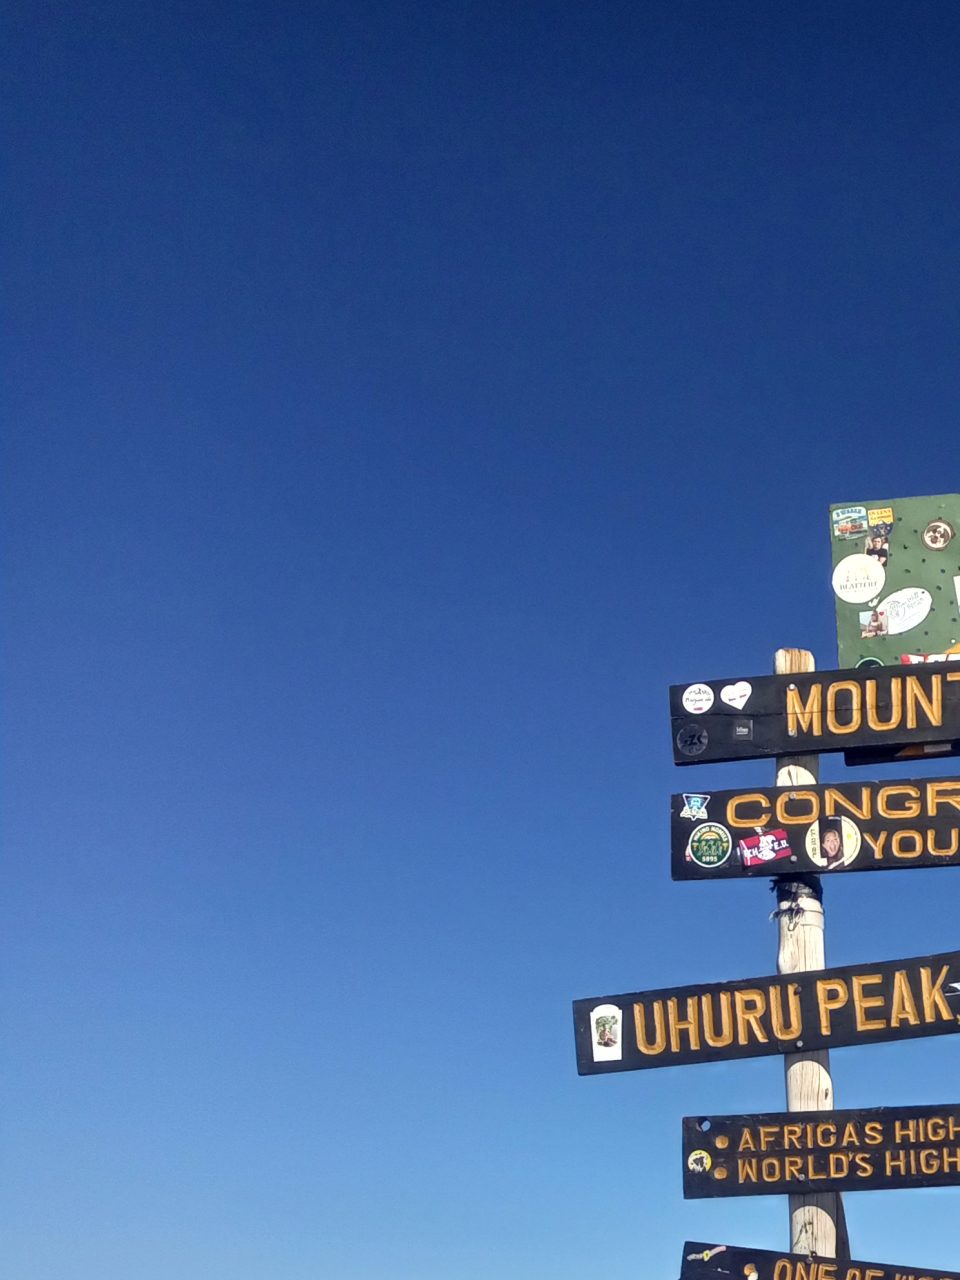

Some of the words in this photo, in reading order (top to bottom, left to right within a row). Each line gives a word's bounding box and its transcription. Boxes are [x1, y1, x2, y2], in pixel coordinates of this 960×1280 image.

[862, 828, 959, 859] YOU
[633, 983, 802, 1055] UHURU
[738, 1151, 873, 1183] WORLD'S
